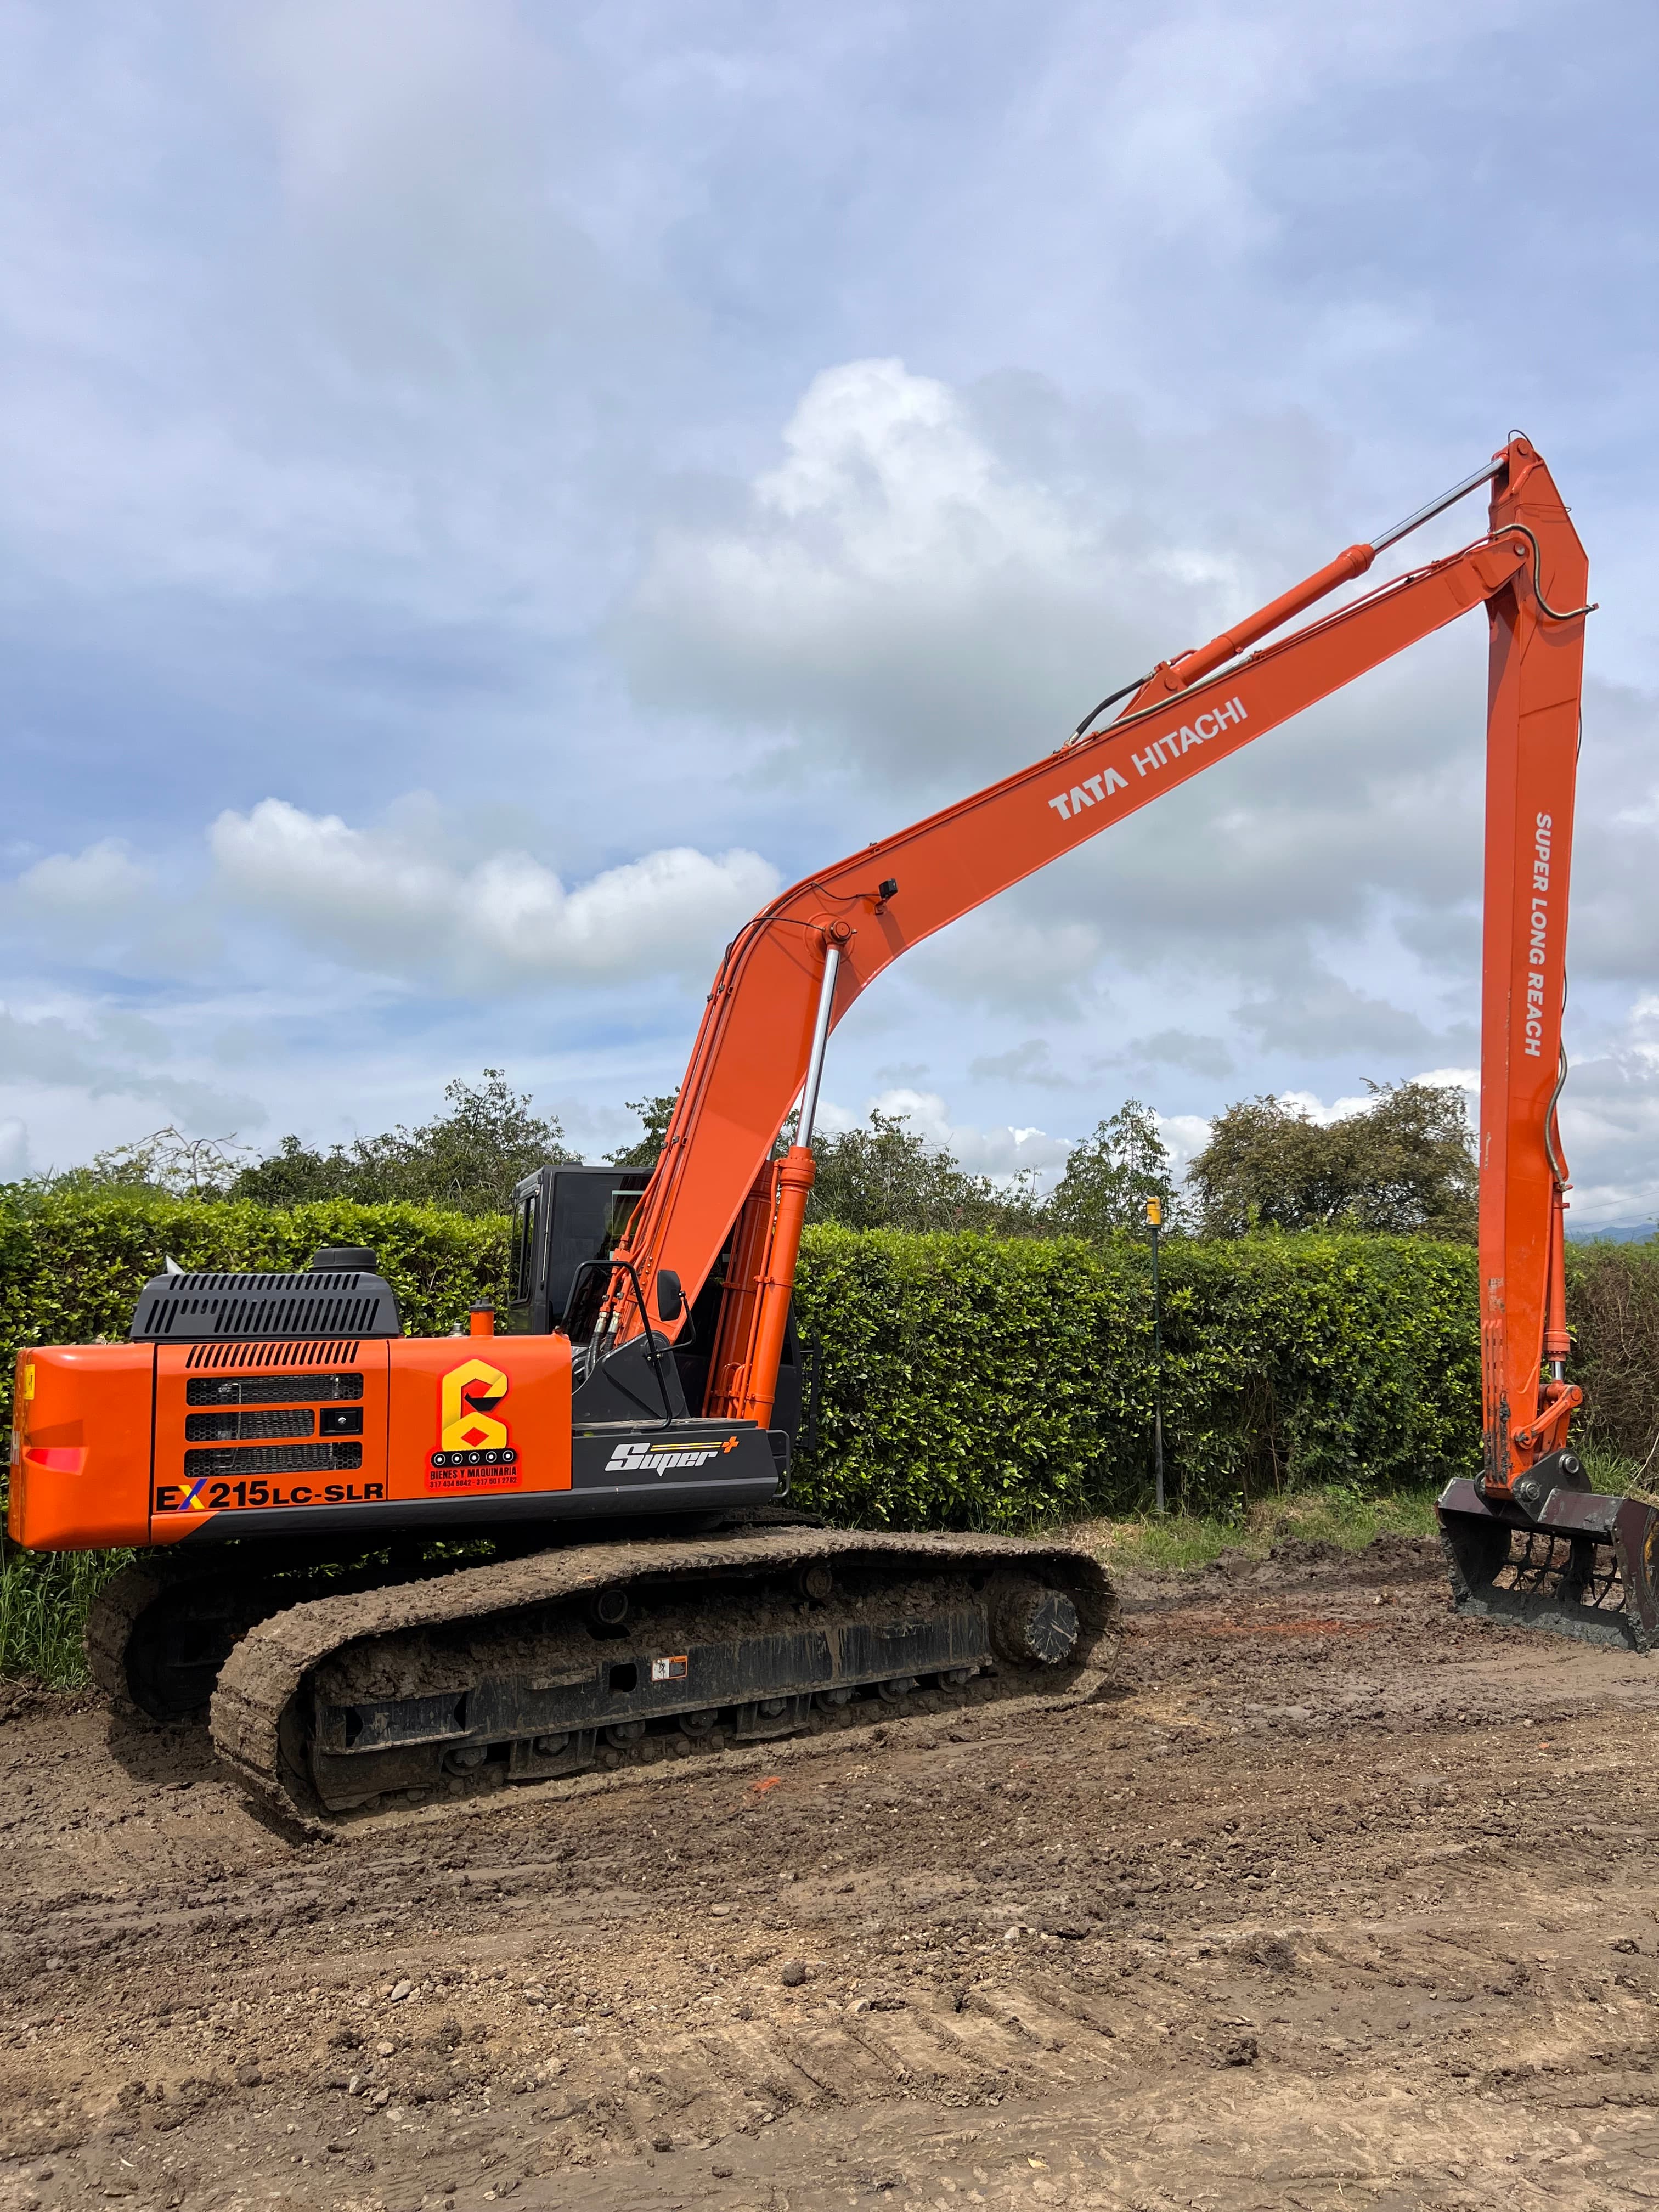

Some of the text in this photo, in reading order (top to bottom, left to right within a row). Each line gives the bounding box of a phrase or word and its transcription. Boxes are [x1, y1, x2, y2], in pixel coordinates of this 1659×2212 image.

[1048, 696, 1248, 821] TATA HITACHI
[1525, 812, 1552, 1058] SUPER LONG REACH
[430, 1466, 517, 1480] BIENES Y MAQUINARIA
